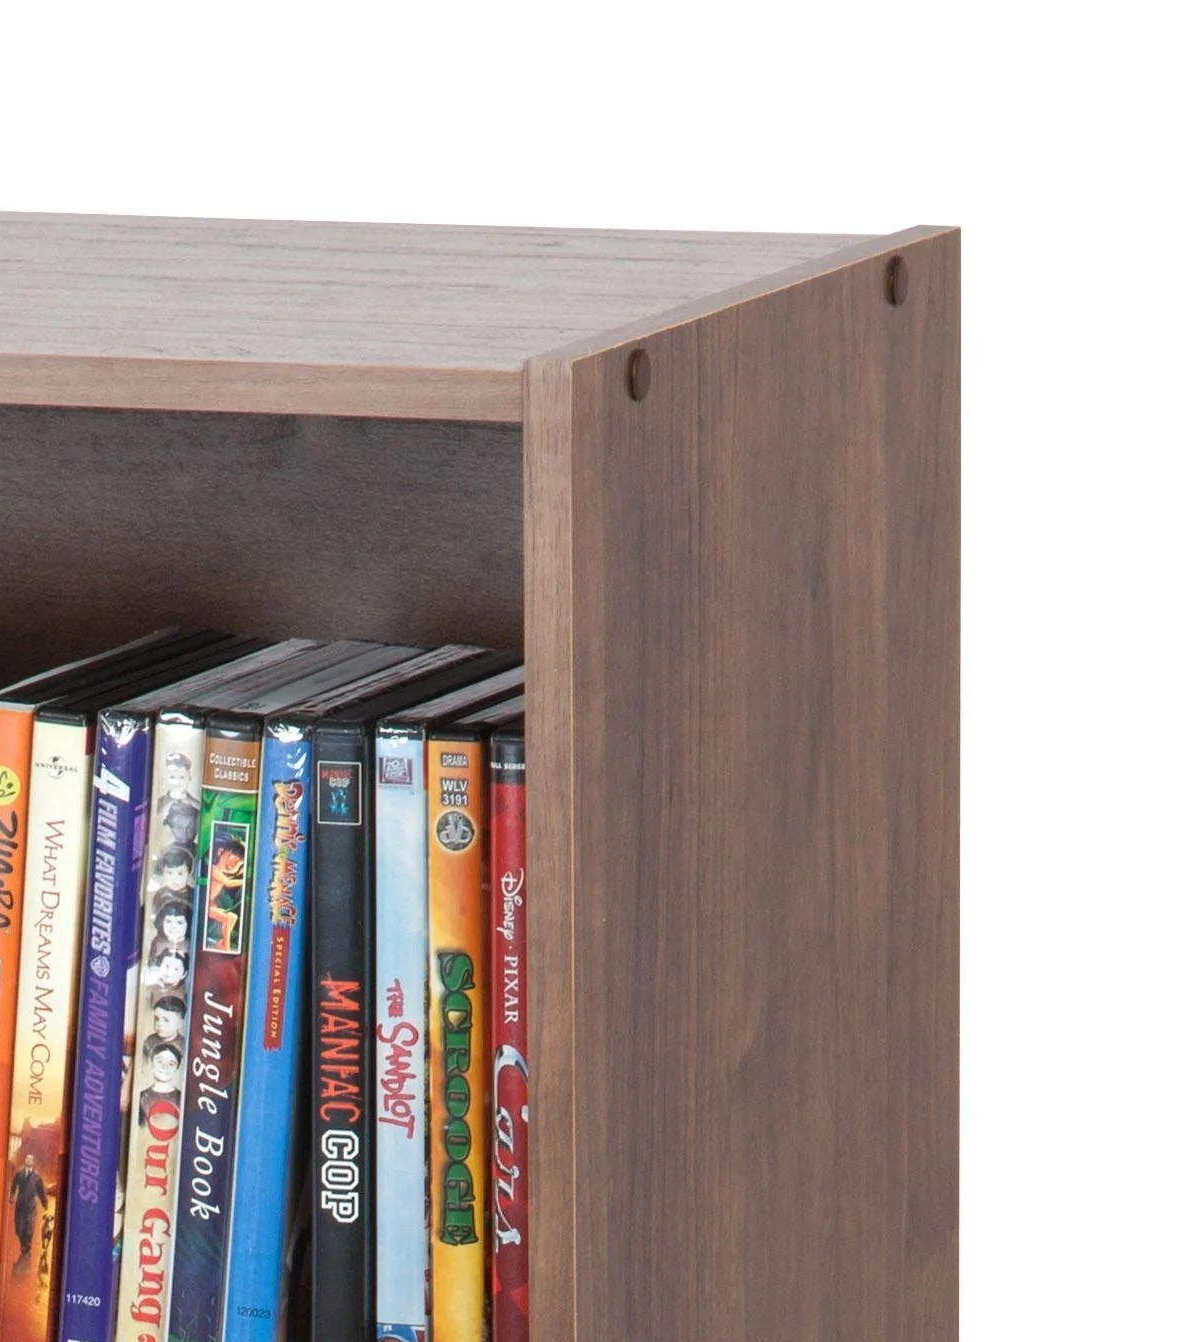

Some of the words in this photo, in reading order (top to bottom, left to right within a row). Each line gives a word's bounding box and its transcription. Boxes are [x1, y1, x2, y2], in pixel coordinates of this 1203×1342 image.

[93, 767, 131, 803] 4
[209, 752, 257, 768] COLLECTIBLE
[214, 768, 250, 782] CLASSICS
[441, 779, 468, 793] WLV
[442, 754, 469, 768] DRAMA
[96, 800, 119, 848] FILM
[442, 794, 468, 806] 3191
[91, 851, 116, 955] FAVORITES
[274, 936, 285, 987] SPECIAL
[503, 955, 519, 1024] PIXAR
[86, 980, 110, 1058] FAMILY
[270, 989, 282, 1039] EDITION
[192, 991, 234, 1115] Jungle
[320, 972, 361, 1124] MANIAC
[437, 949, 478, 1245] SCROOGE
[79, 1060, 106, 1204] ADVENTURES
[144, 1100, 180, 1197] Our
[189, 1126, 224, 1221] Book
[321, 1129, 359, 1223] COP
[130, 1207, 172, 1327] Gang
[66, 1293, 101, 1307] 117420
[237, 1306, 271, 1319] 120023
